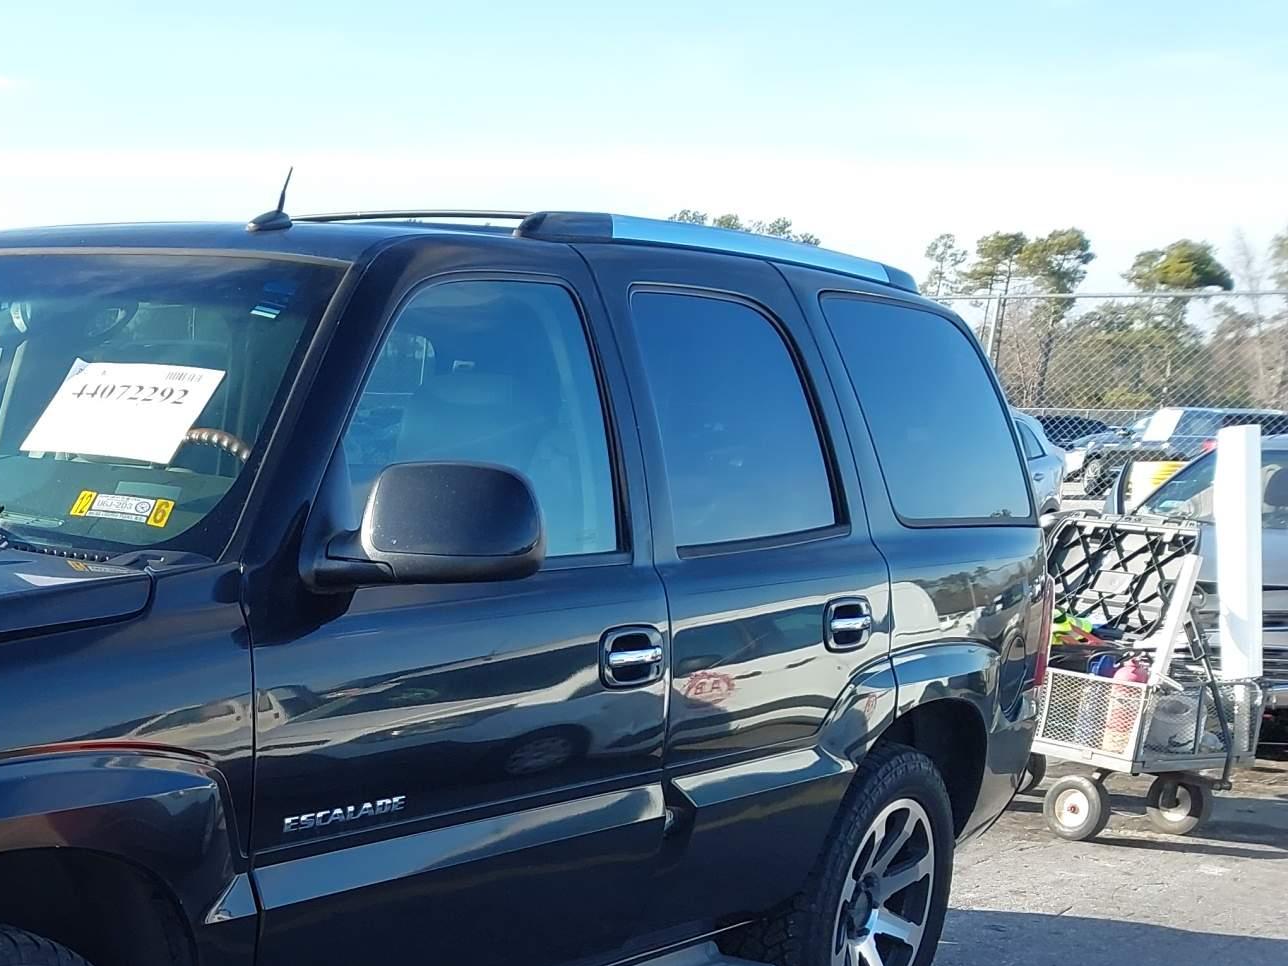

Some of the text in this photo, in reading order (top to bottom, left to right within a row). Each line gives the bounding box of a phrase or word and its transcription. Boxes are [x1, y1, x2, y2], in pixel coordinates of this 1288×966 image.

[72, 384, 189, 405] 44072292
[153, 502, 169, 523] 6
[282, 795, 407, 832] ESCALADE
